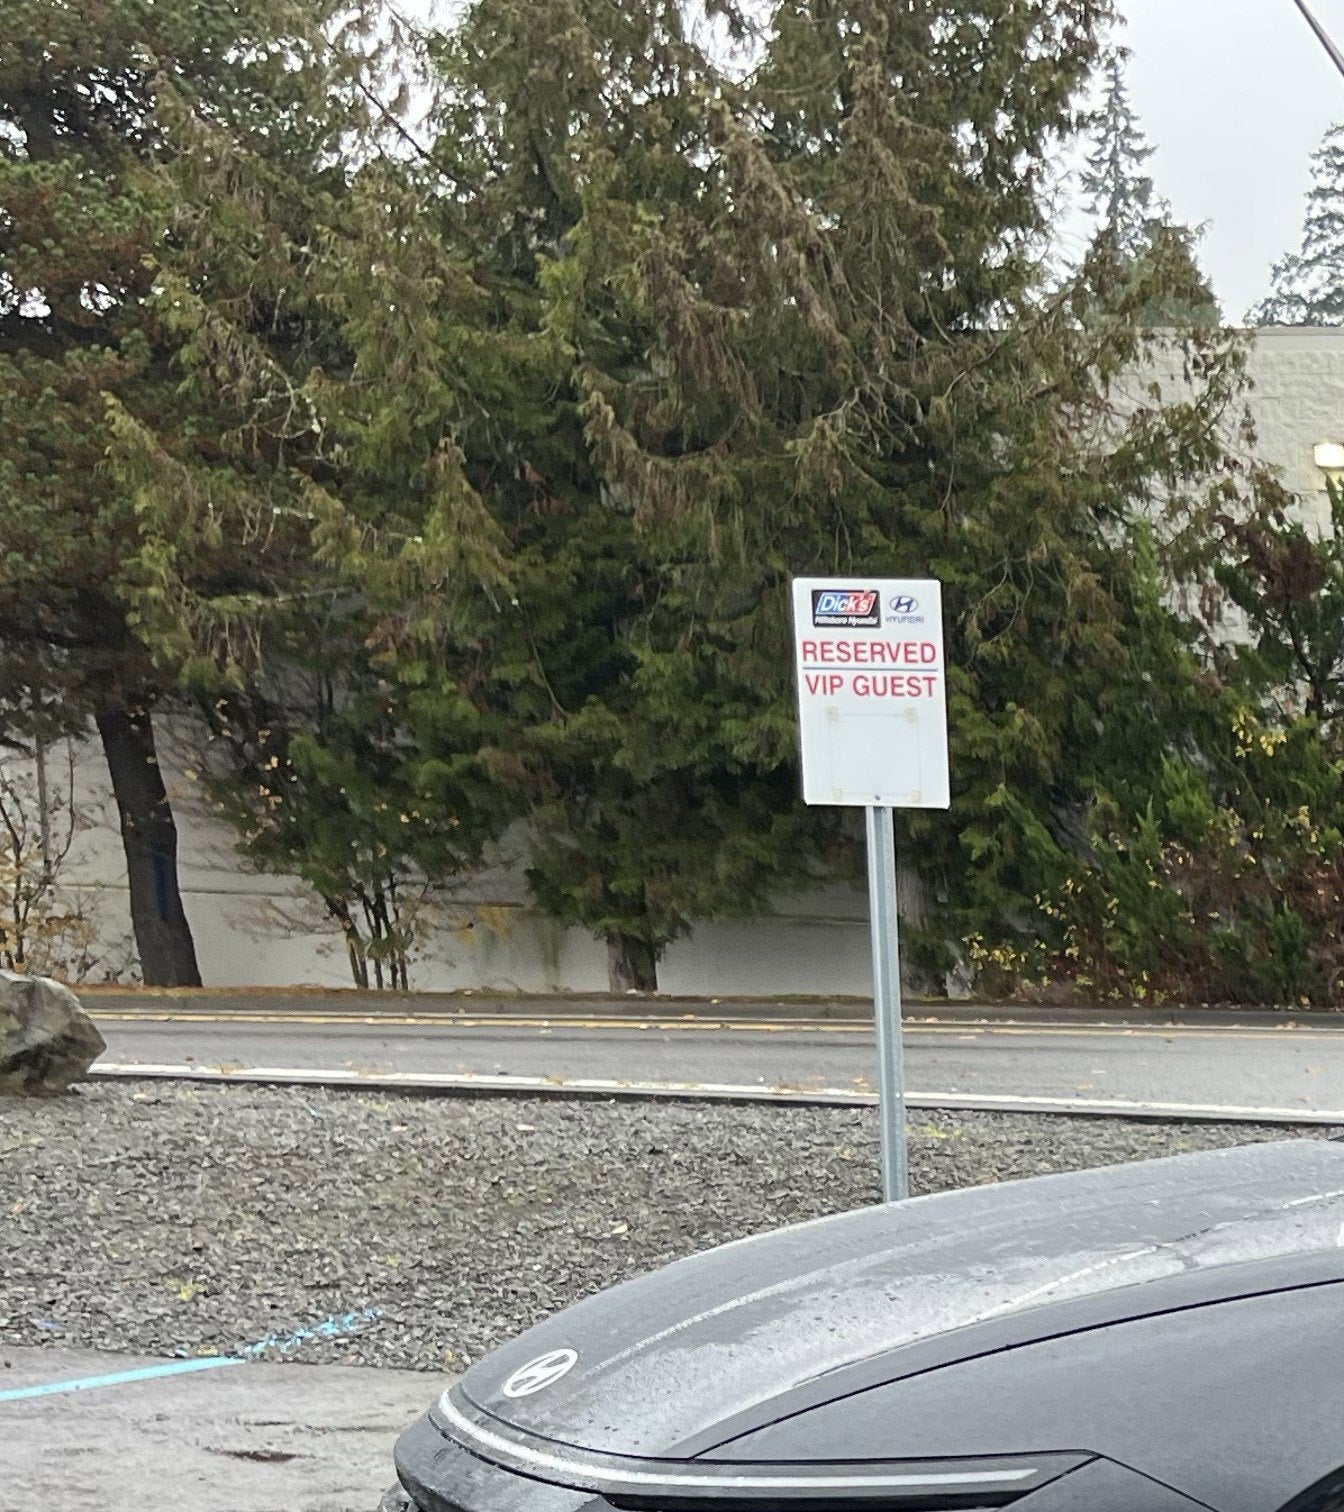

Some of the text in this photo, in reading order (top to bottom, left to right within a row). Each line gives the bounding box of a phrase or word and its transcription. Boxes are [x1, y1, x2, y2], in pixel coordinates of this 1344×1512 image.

[802, 641, 936, 663] RESERVED
[805, 675, 937, 697] VIP GUEST
